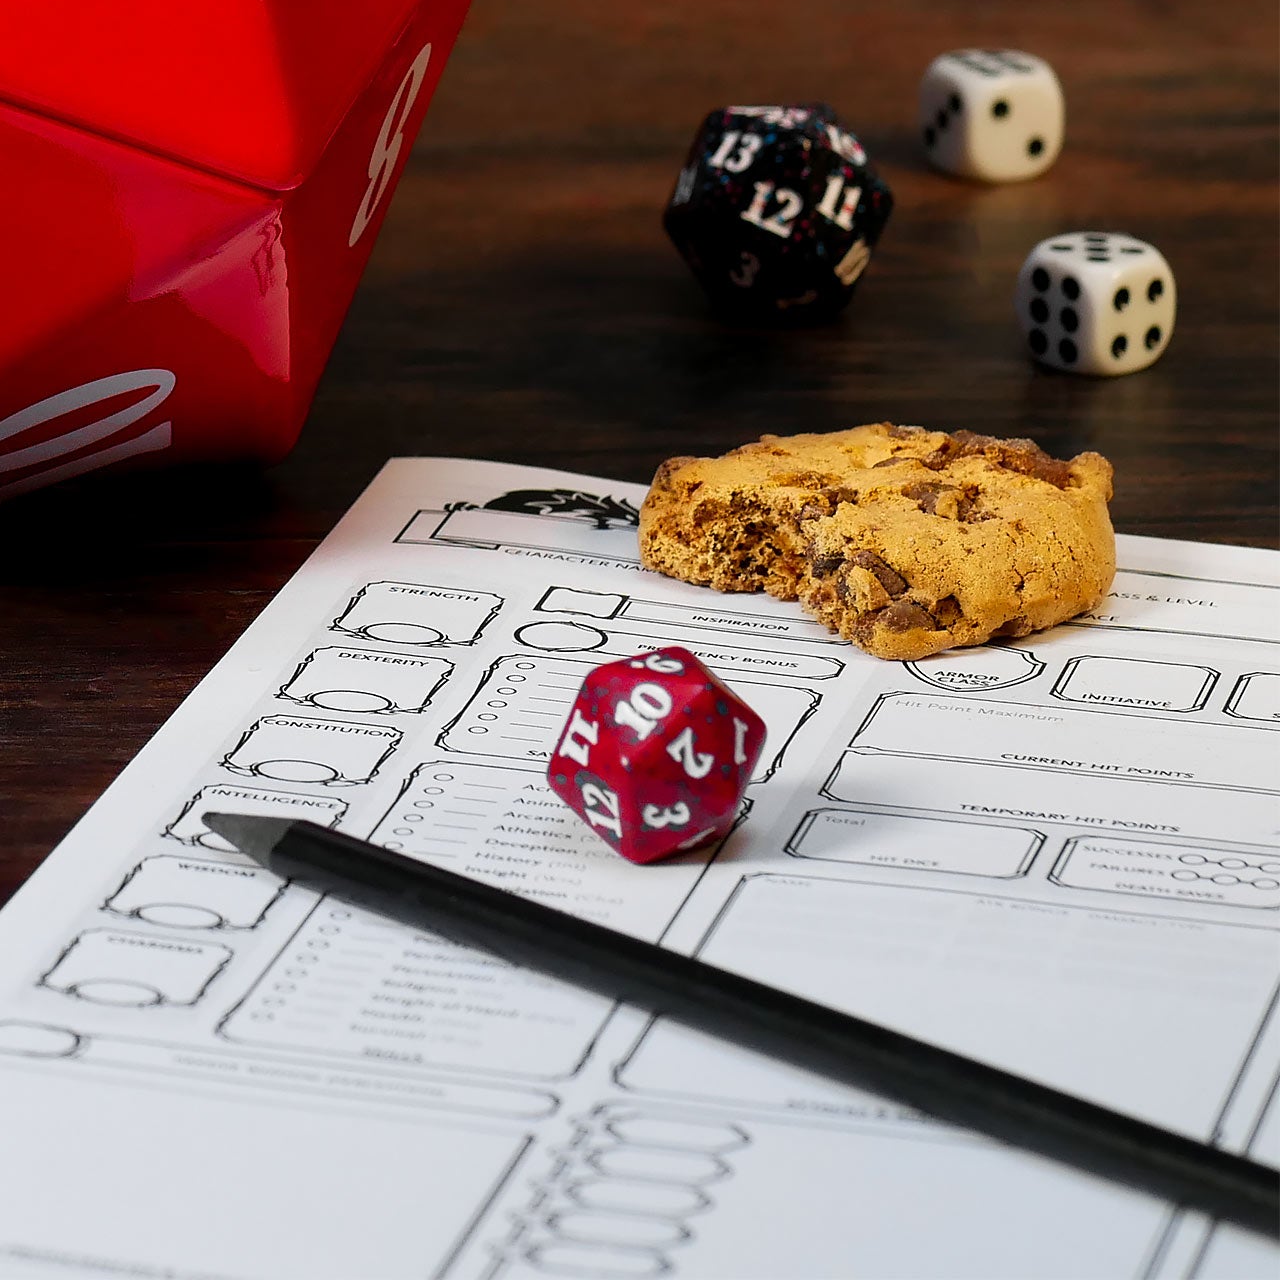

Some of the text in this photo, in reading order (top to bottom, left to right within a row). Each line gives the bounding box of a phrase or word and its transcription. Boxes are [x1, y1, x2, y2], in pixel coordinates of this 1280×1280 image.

[348, 43, 431, 247] 8
[708, 130, 762, 173] 13
[740, 180, 804, 239] 12
[816, 175, 862, 232] 11
[504, 548, 610, 567] CHARACTER
[388, 586, 479, 602] STRENGTH
[1106, 592, 1141, 600] ASS
[1165, 597, 1219, 608] LEVEL
[692, 615, 790, 632] INSPIRATION
[1083, 613, 1120, 622] ACE
[338, 651, 430, 668] DEXTERITY
[742, 657, 799, 669] BONUS
[933, 670, 1000, 682] ARMOR
[937, 676, 991, 687] CLASS
[1081, 692, 1173, 708] INITIATIVE
[615, 682, 672, 741] 10
[895, 699, 1065, 722] Hit Point Maximum
[263, 718, 398, 739] CONSTITUTION
[666, 727, 714, 779] 2
[999, 753, 1195, 779] CURRENT HIT POINTS
[211, 788, 339, 810] INTELLIGENCE
[503, 811, 566, 825] Arcana
[581, 782, 622, 839] 12
[642, 801, 690, 829] 3
[959, 804, 1181, 833] TEMPORARY HIT POINTS
[824, 815, 866, 827] Total
[493, 824, 573, 840] Athletics
[485, 837, 579, 856] Deception
